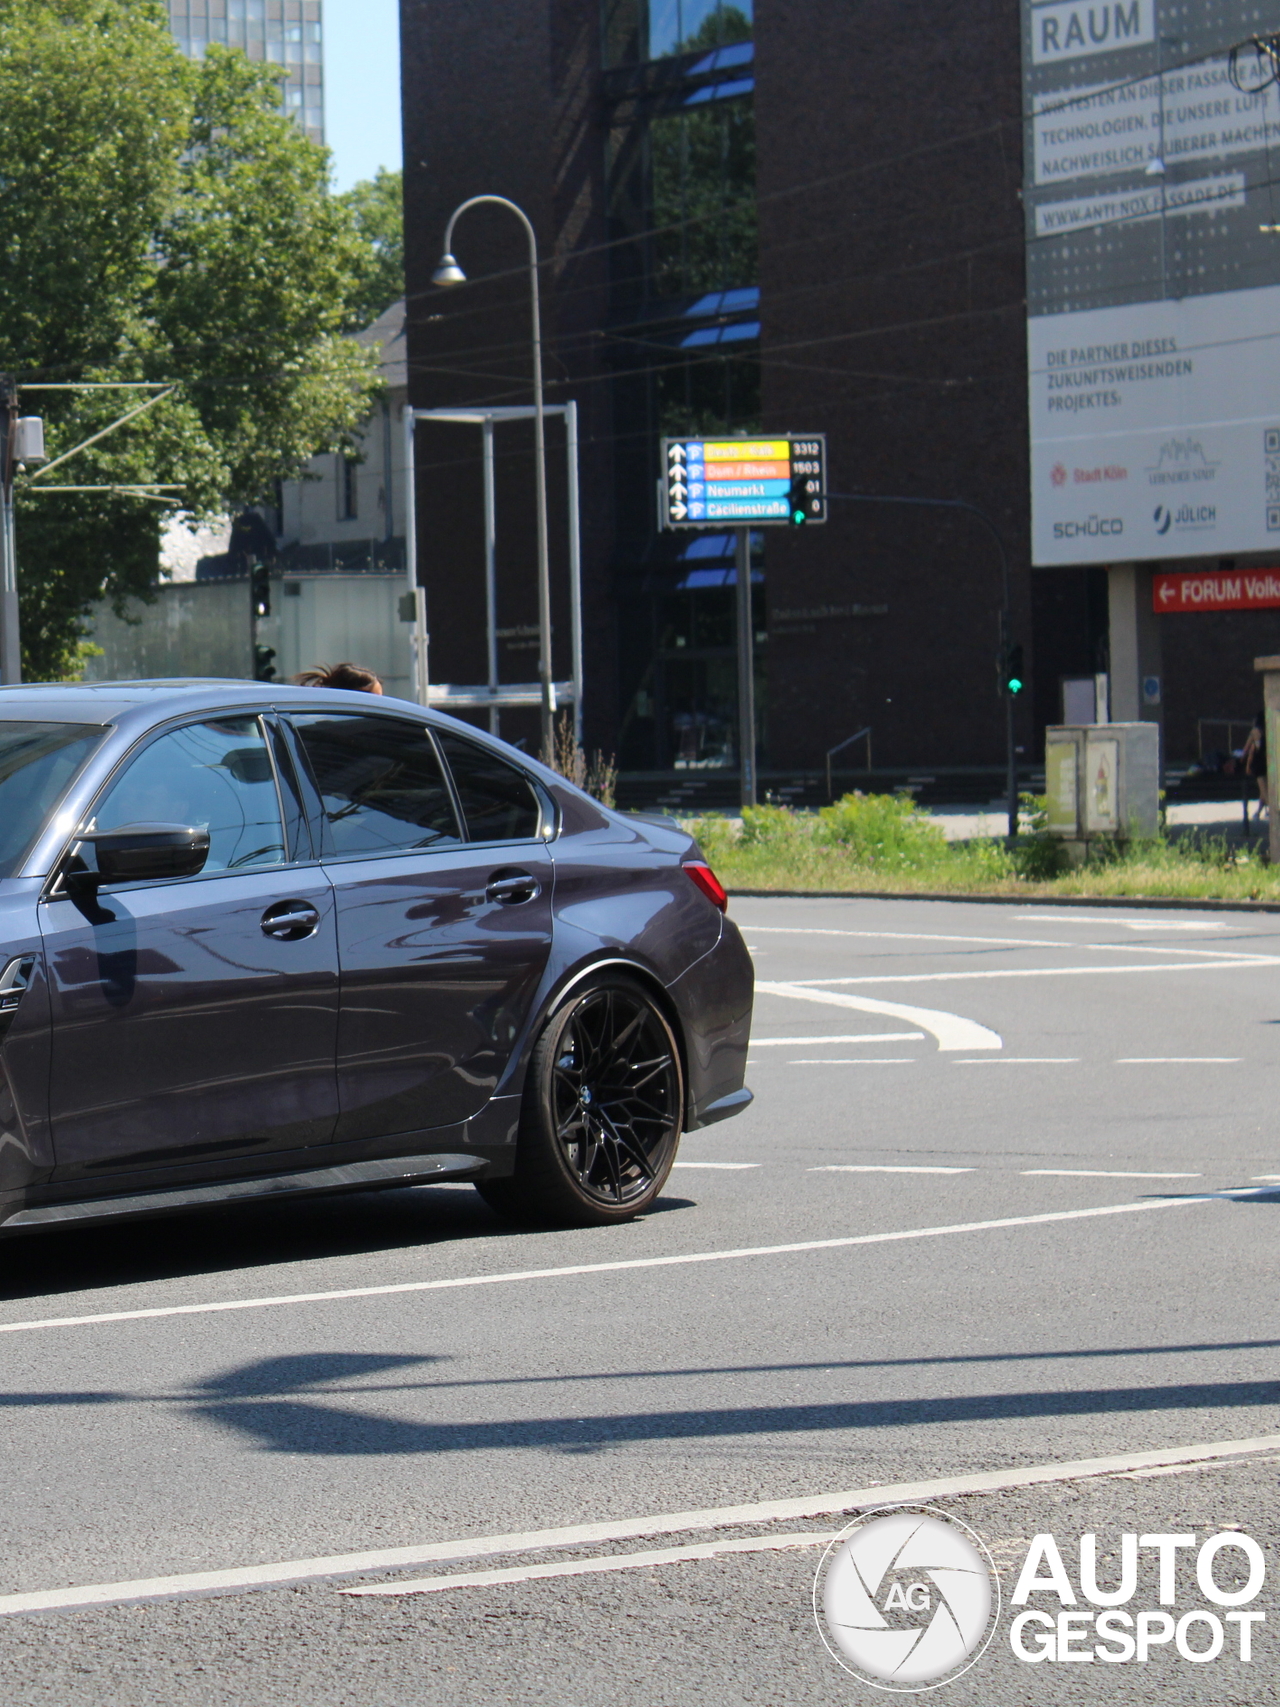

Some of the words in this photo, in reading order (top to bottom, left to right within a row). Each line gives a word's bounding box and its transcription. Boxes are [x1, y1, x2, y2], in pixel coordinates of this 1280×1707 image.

[1041, 2, 1140, 53] RAUM
[1118, 85, 1137, 104] AN
[1177, 99, 1231, 123] UNSERE
[1235, 91, 1270, 113] LUFT
[1042, 145, 1144, 176] NACHWEISLICH
[1046, 350, 1068, 366] DIE
[1071, 343, 1129, 364] PARTNER
[1131, 337, 1177, 359] DIESES
[1047, 358, 1193, 390] ZUKUNFTSWEISENDEN
[793, 442, 819, 456] 3312
[707, 464, 734, 478] Dom
[744, 463, 777, 476] Rhein
[793, 461, 819, 474] 1503
[1073, 467, 1102, 484] Stadt
[1103, 464, 1128, 481] Köln
[707, 483, 765, 497] Neumarkt
[707, 501, 787, 516] Cäcilienstraße
[1175, 503, 1216, 524] JÜLICH
[1053, 513, 1123, 540] SCHÜCO
[1181, 577, 1241, 604] FORUM
